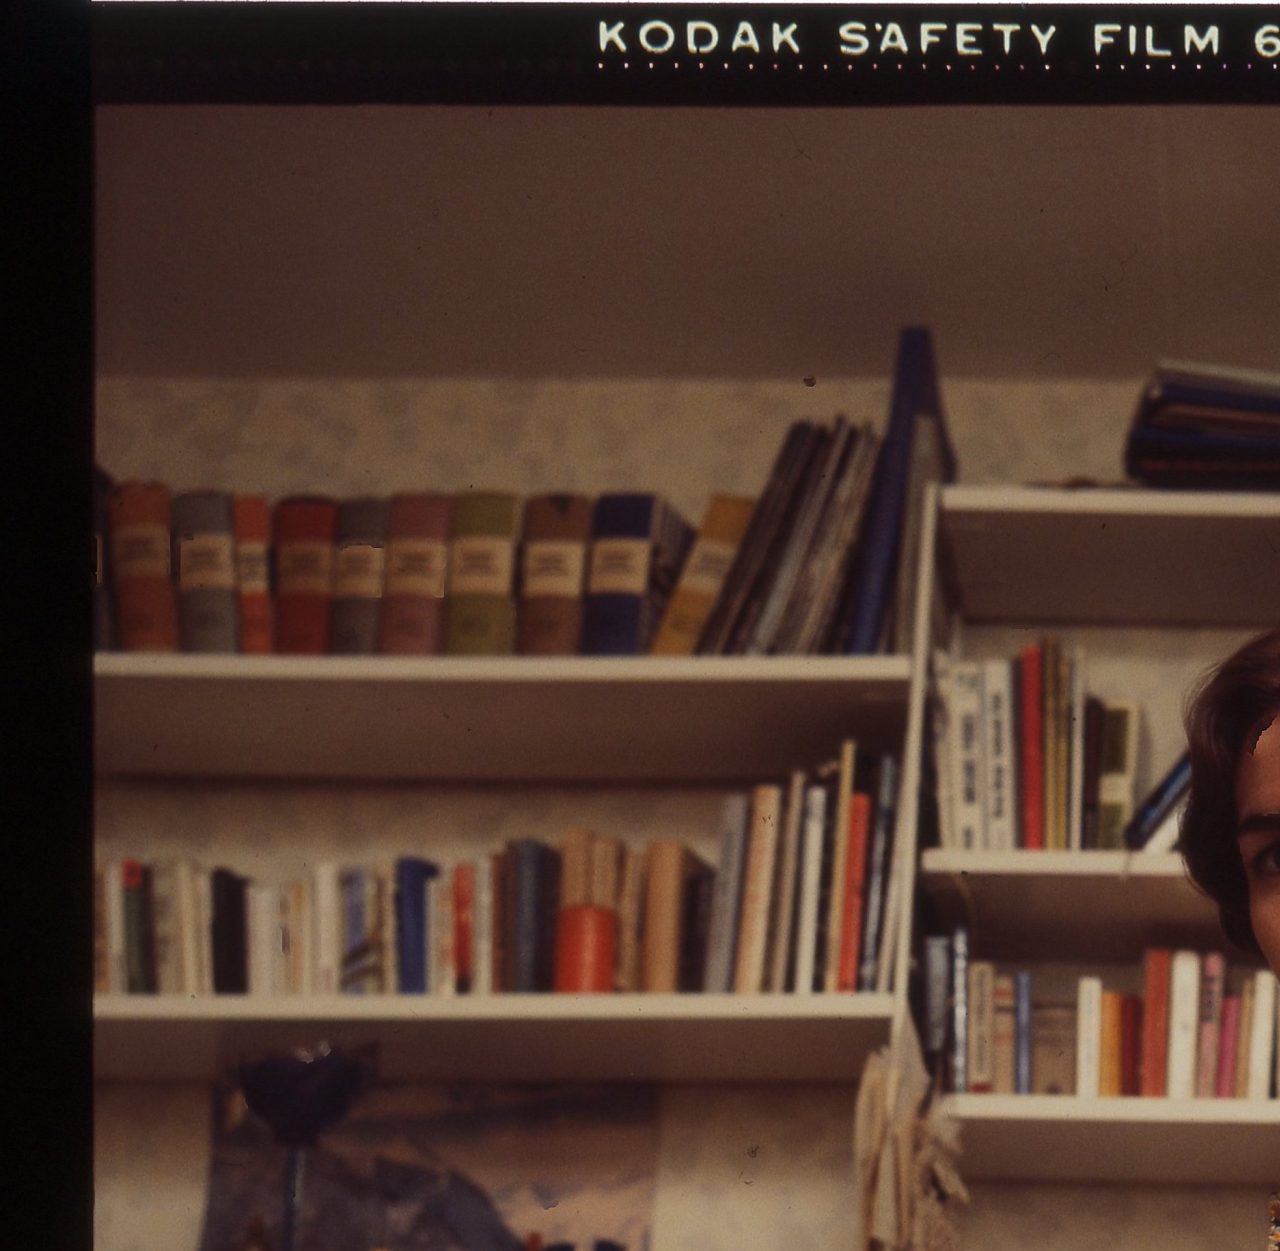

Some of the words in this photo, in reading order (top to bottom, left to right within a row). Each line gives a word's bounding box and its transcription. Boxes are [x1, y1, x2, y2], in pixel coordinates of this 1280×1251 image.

[598, 20, 802, 54] KODAK
[839, 22, 1058, 56] SAFETY
[1095, 24, 1221, 56] FILM
